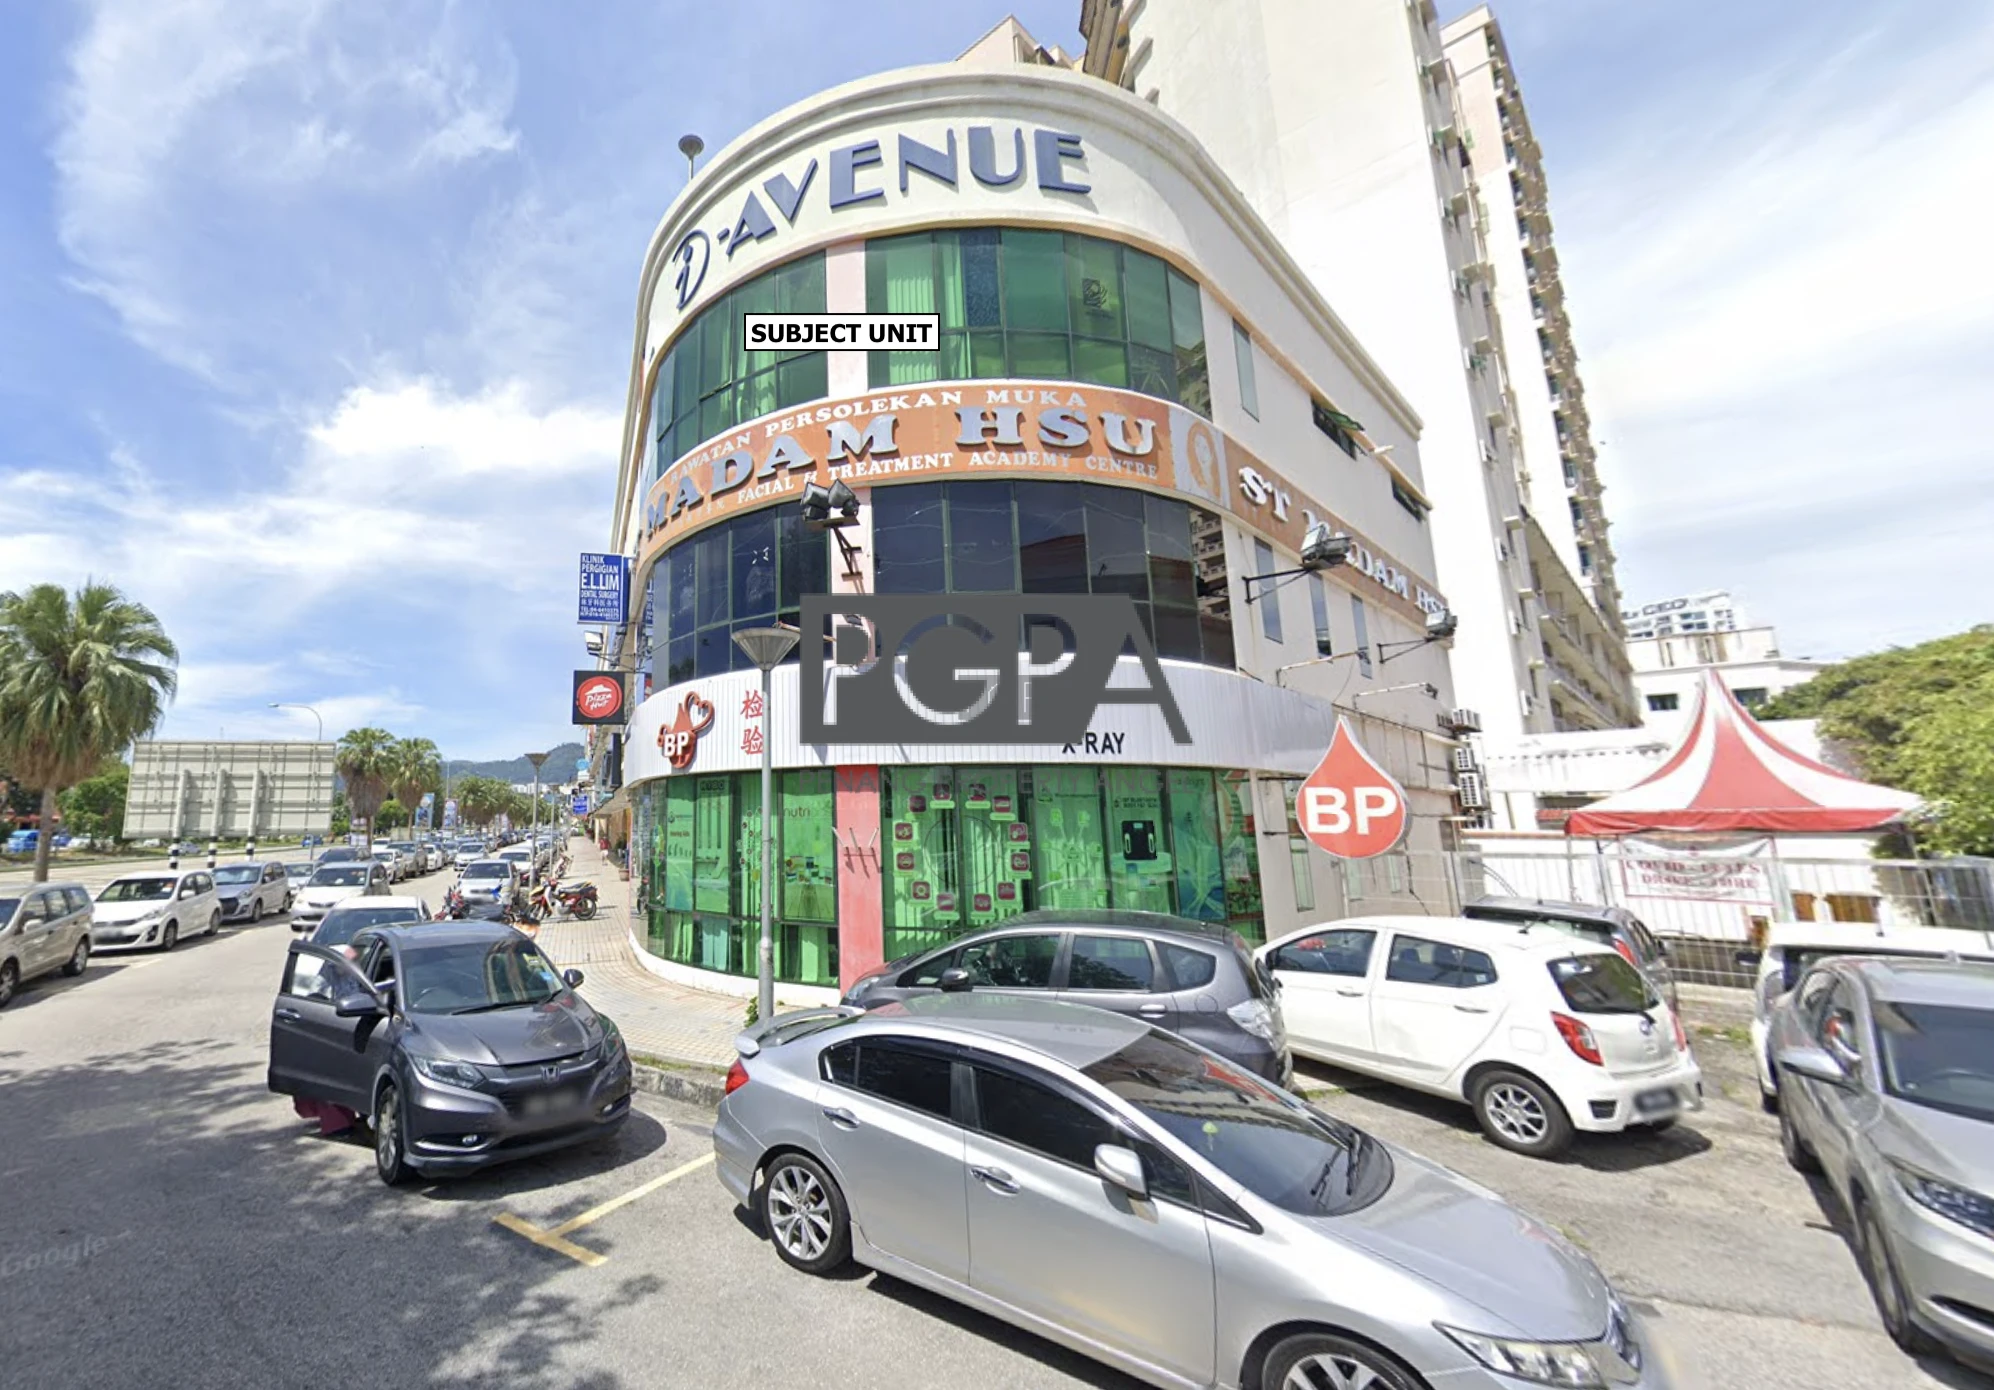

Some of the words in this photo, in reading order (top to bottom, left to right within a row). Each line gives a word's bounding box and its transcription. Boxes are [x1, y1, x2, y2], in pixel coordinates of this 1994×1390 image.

[765, 389, 962, 438] PERSOLEKAN
[986, 388, 1087, 407] MUKA
[645, 414, 900, 538] MADAM
[954, 405, 1157, 456] HSU
[738, 477, 794, 505] FACIAL
[827, 452, 954, 481] TREATMENT
[968, 451, 1071, 469] ACADEMY
[1086, 453, 1159, 480] CENTRE
[1239, 466, 1292, 523] ST
[581, 563, 619, 575] PERGIGIAN
[582, 554, 605, 564] KLINIK
[585, 693, 612, 706] Pizza
[590, 699, 609, 711] Hut
[663, 731, 690, 757] BP
[1304, 786, 1398, 835] BP
